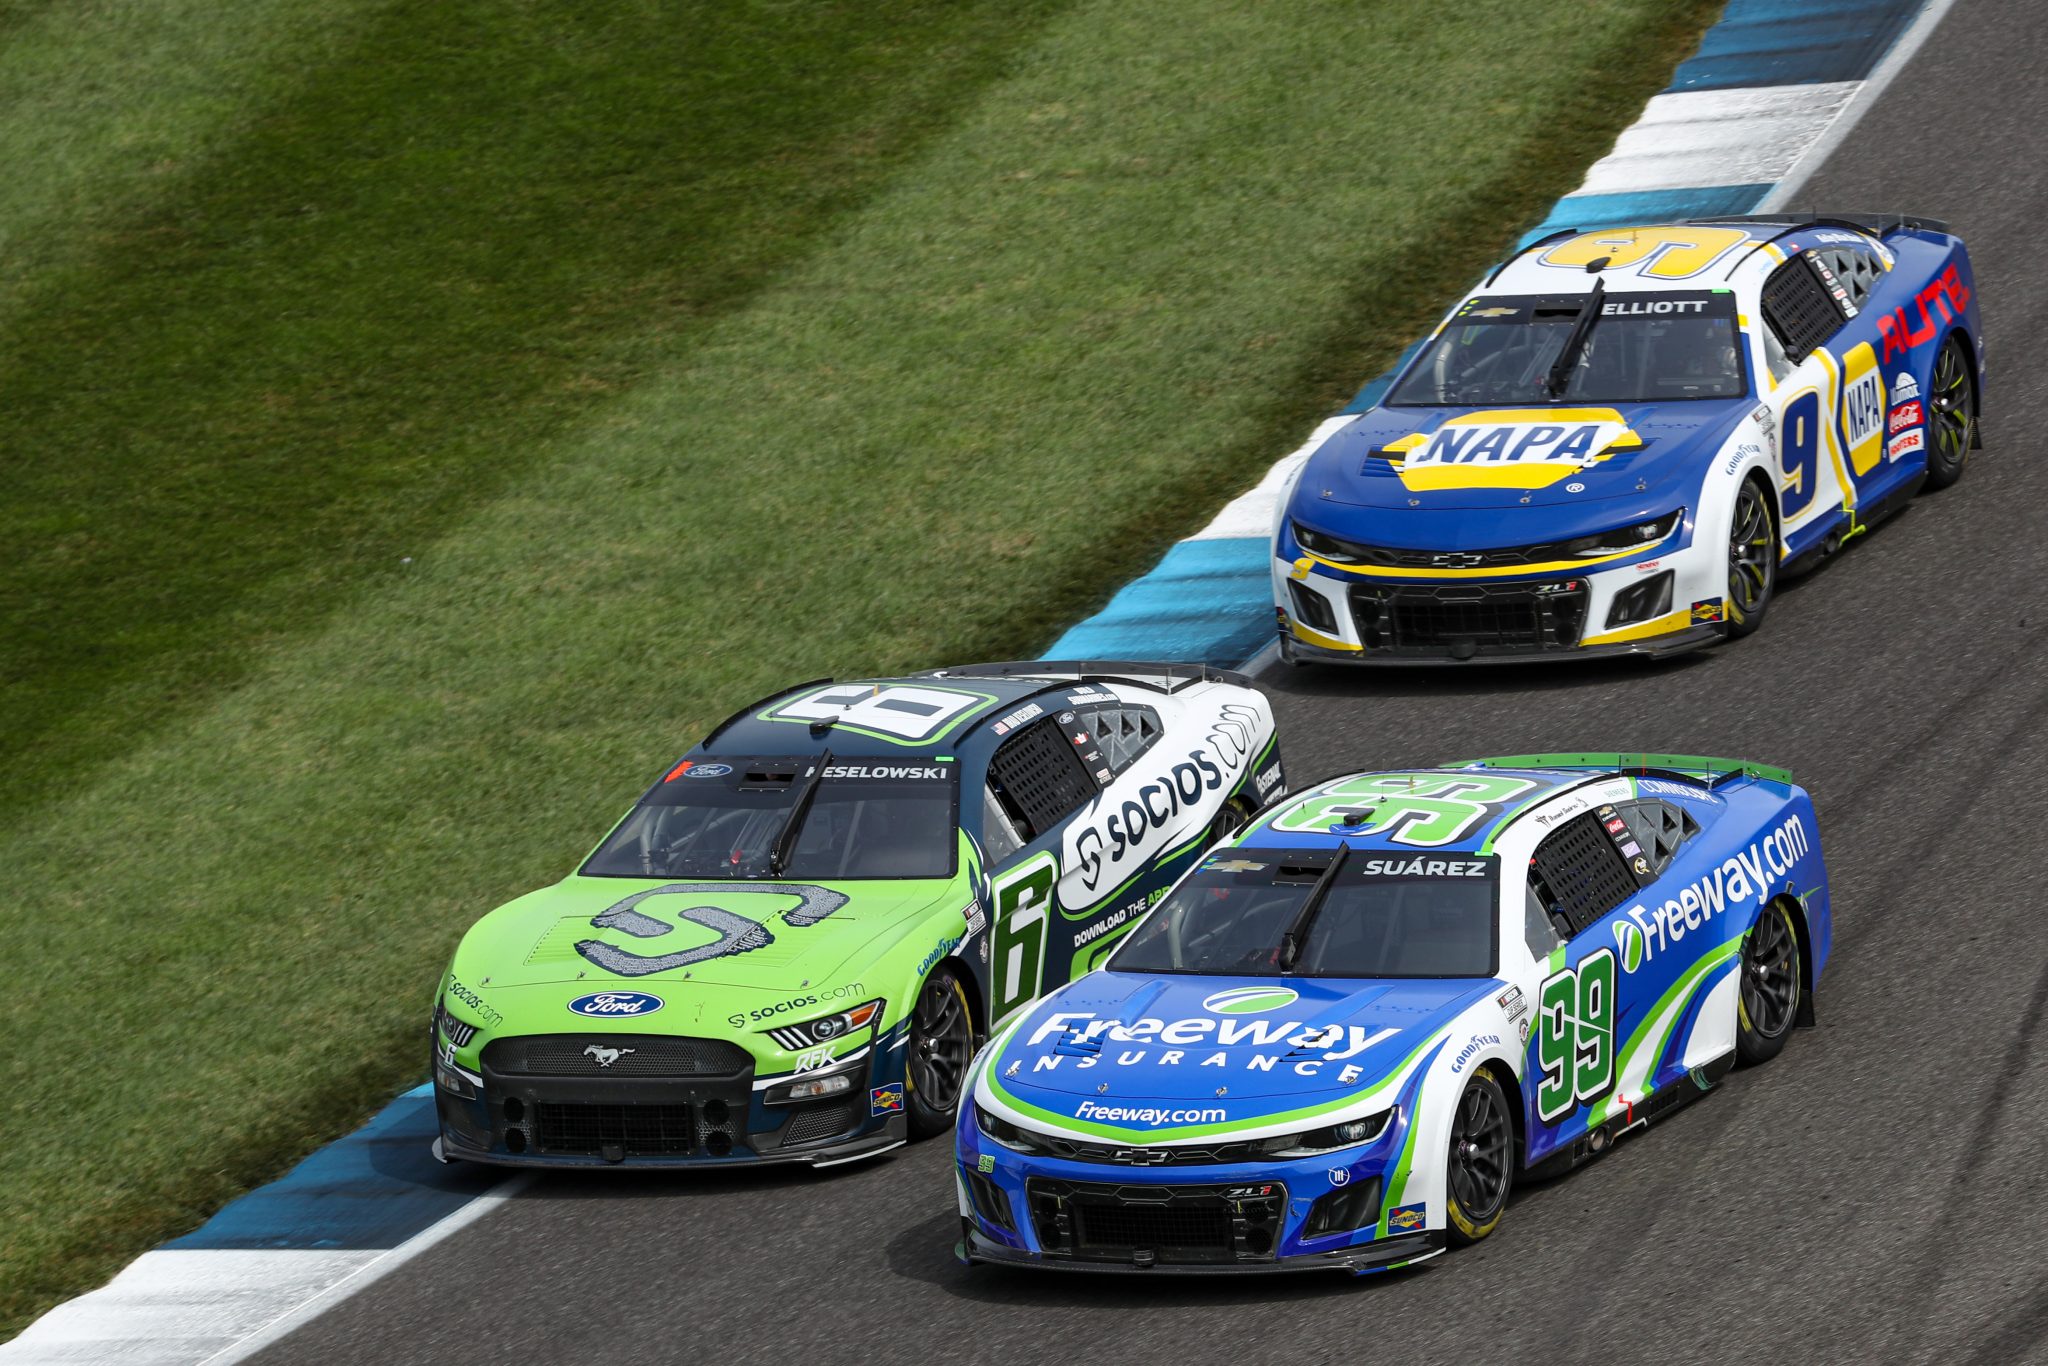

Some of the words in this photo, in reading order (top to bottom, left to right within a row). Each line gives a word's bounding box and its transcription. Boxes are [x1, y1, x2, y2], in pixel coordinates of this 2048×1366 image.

[1601, 301, 1708, 315] ELLIOTT
[1847, 376, 1882, 443] NAPA
[1416, 425, 1600, 463] NAPA
[1779, 387, 1820, 522] 9
[1364, 856, 1487, 877] SUÁREZ
[1628, 814, 1809, 961] Freeway.com
[1074, 909, 1127, 947] DOWNLOAD
[1127, 898, 1146, 917] THE
[916, 938, 961, 976] GOODYEAR
[991, 860, 1055, 1031] 6
[584, 993, 647, 1014] Ford
[1026, 1012, 1402, 1061] Freeway
[1451, 1034, 1501, 1073] GOODYEAR
[1538, 950, 1614, 1122] 99
[444, 1043, 458, 1068] 6
[793, 1046, 836, 1074] RFK
[1010, 1050, 1364, 1083] INSURANCE
[873, 1092, 902, 1108] SUNOCO
[1075, 1100, 1227, 1123] Freeway.com
[978, 1154, 996, 1174] 99
[1389, 1210, 1426, 1226] SUNOCO
